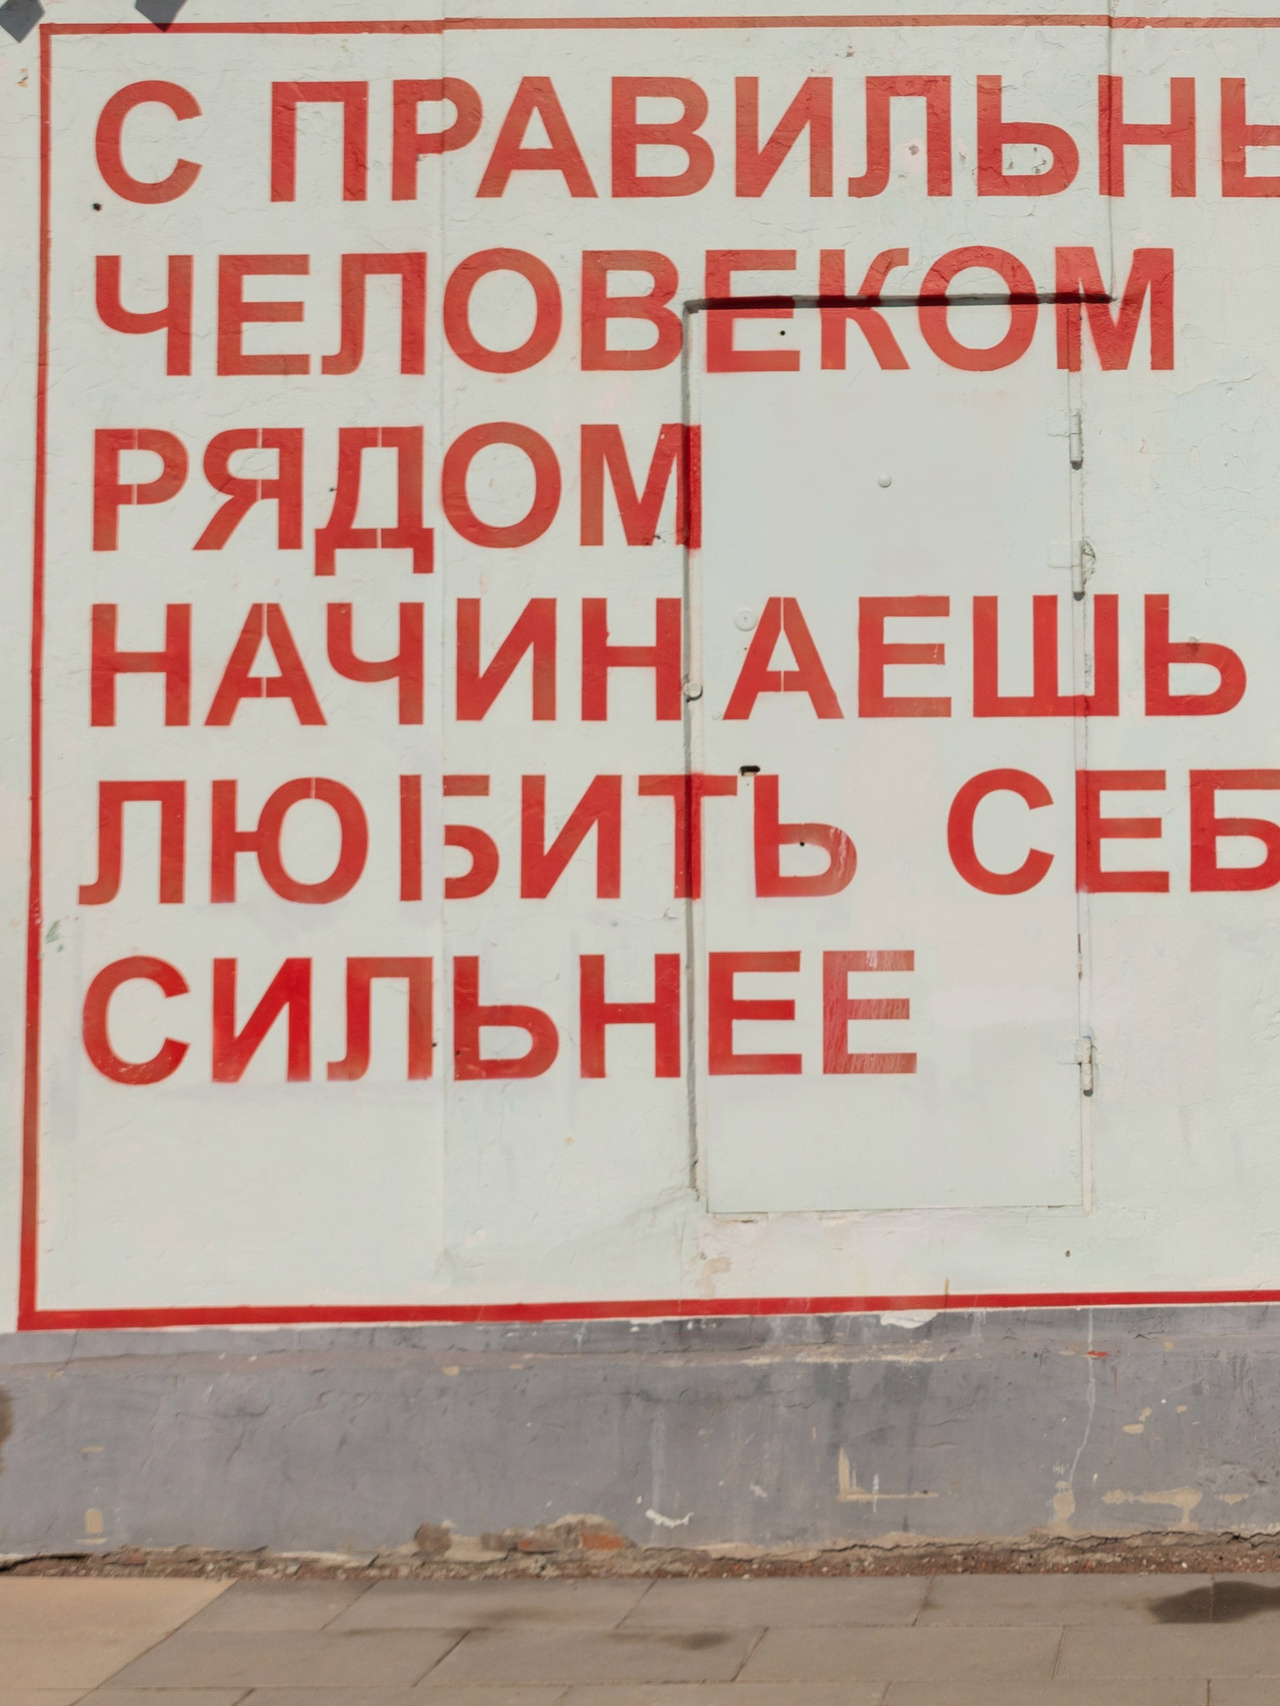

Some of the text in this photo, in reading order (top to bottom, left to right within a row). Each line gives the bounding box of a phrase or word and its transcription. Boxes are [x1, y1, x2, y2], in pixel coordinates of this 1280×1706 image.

[95, 80, 202, 204] С
[94, 246, 1175, 376] ЧЕЛОВЕКОМ
[92, 422, 702, 576] РЯДОМ
[90, 594, 1247, 727] НАЧИНАЕШЬ
[78, 772, 858, 906] ЛЮБИТЬ
[82, 950, 917, 1086] СИЛЬНЕЕ
